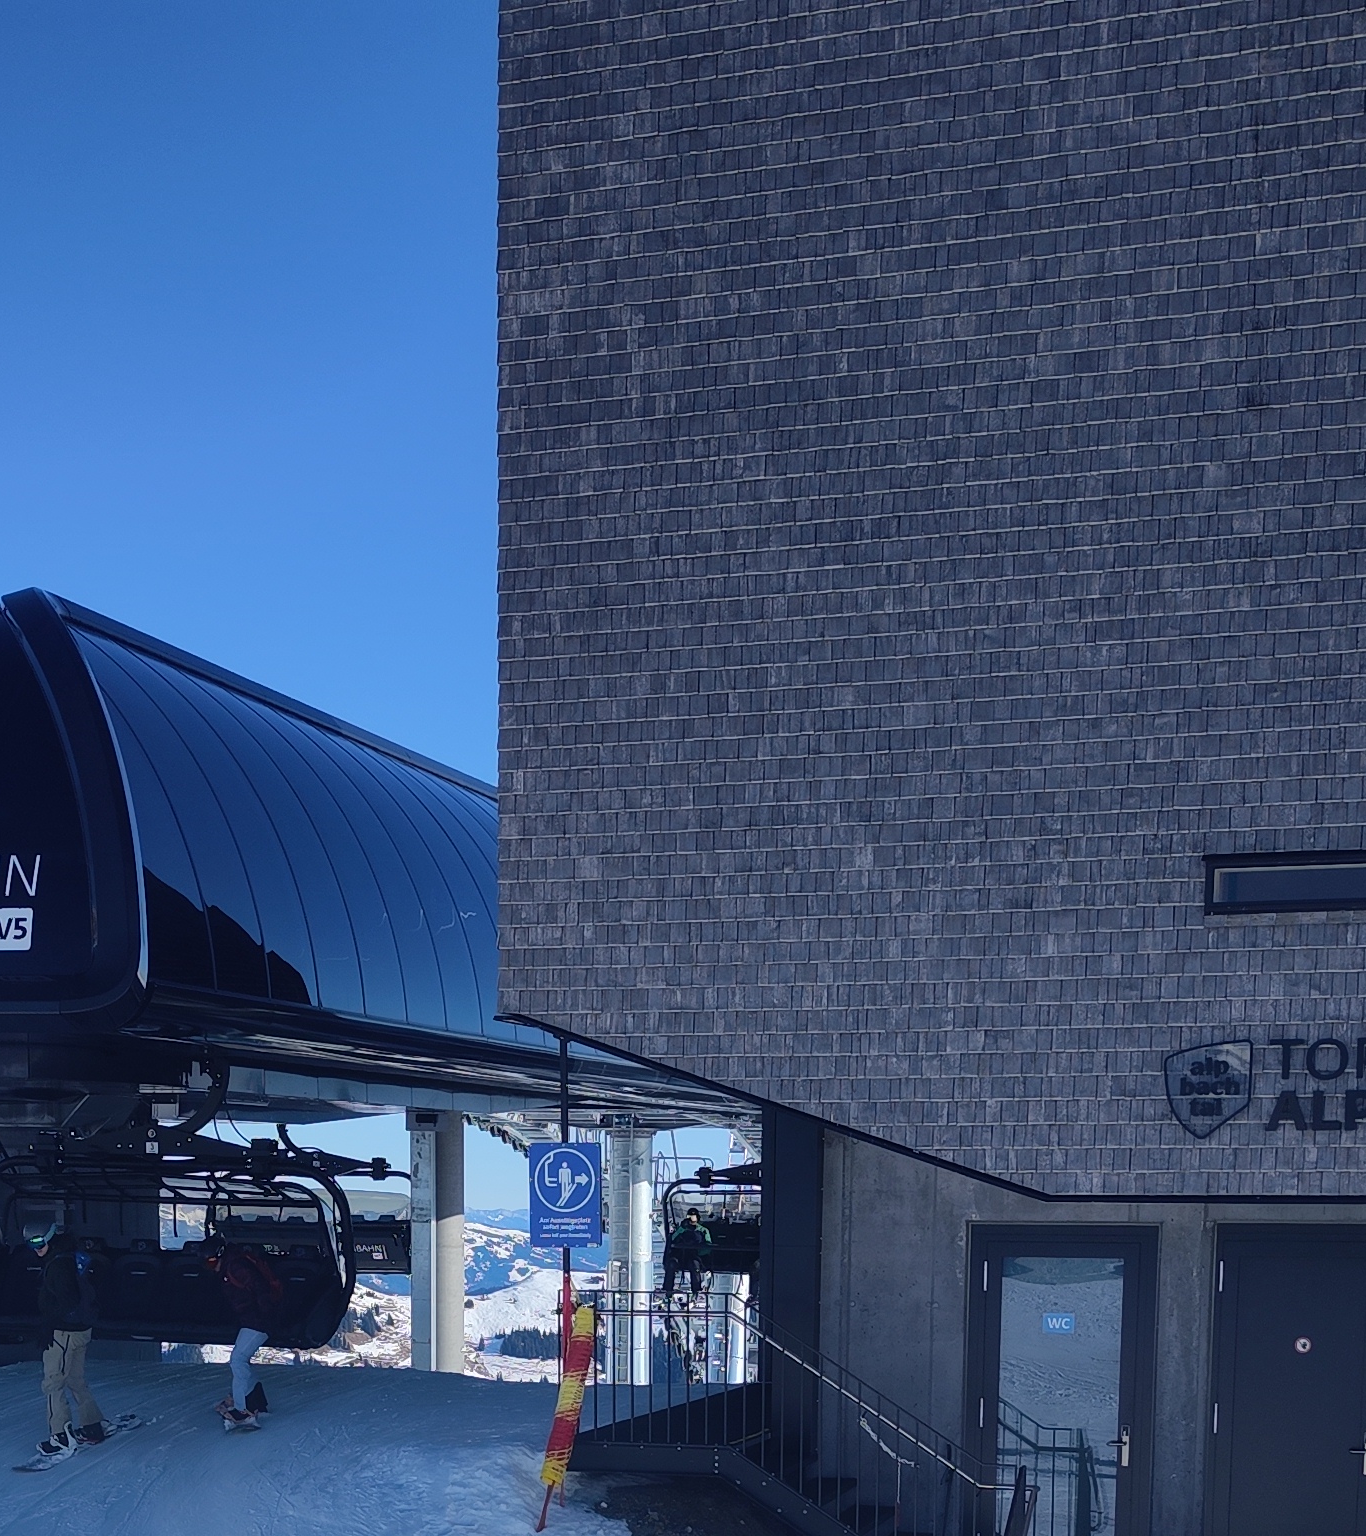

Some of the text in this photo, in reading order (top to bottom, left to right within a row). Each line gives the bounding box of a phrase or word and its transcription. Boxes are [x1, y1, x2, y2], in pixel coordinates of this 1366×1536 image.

[1190, 1056, 1230, 1078] alp
[1180, 1076, 1240, 1095] bach
[1190, 1098, 1223, 1116] tal
[354, 1244, 383, 1252] BAHN
[1047, 1317, 1071, 1329] WC
